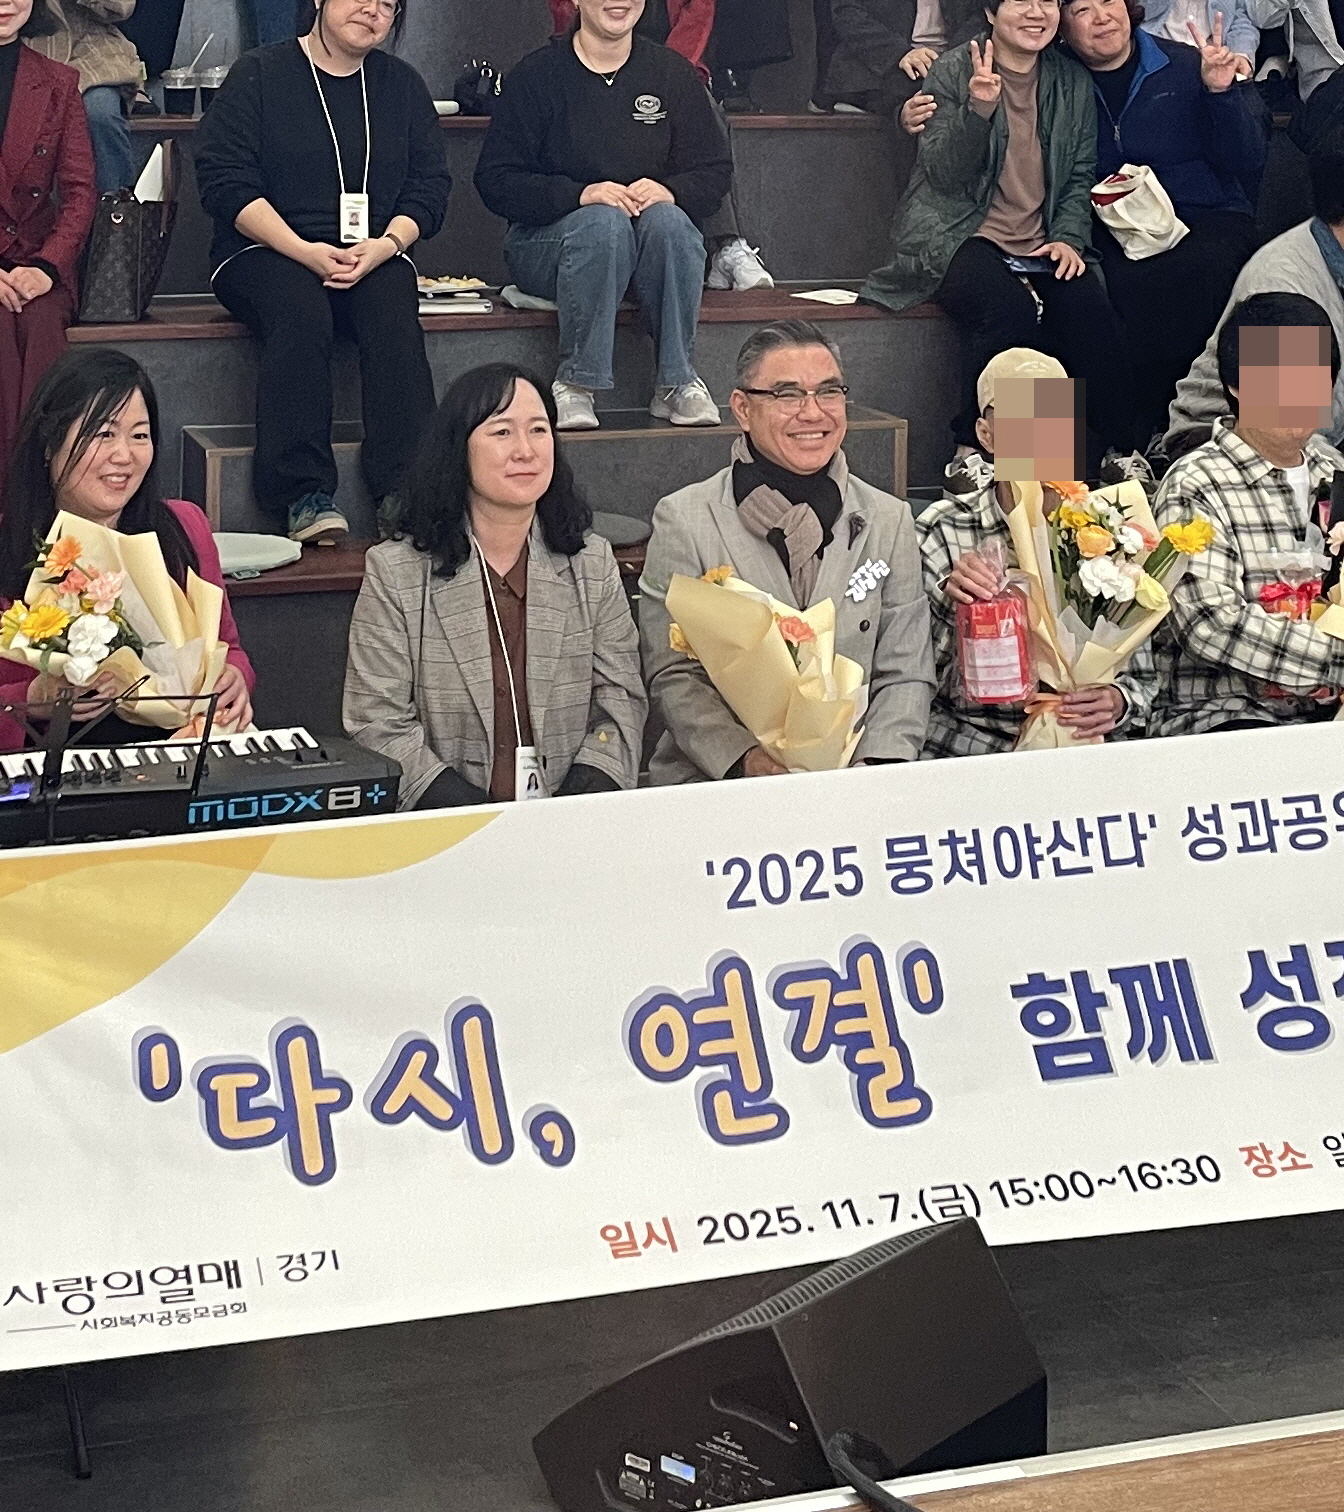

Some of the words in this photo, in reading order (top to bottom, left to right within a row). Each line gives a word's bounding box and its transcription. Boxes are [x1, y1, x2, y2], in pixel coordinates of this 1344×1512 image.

[706, 844, 864, 910] '2025
[885, 812, 1157, 896] 뭉쳐야산다'
[134, 1000, 576, 1186] '다시,
[628, 938, 944, 1146] 연결'
[1009, 957, 1216, 1083] 함께
[599, 1216, 680, 1260] 일시
[989, 1154, 1222, 1209] 15:00~16:30
[1238, 1139, 1314, 1179] 장소
[2, 1259, 244, 1316] 사랑의열매
[276, 1249, 341, 1283] 경기
[80, 1301, 248, 1332] 사회복지공동모금회
